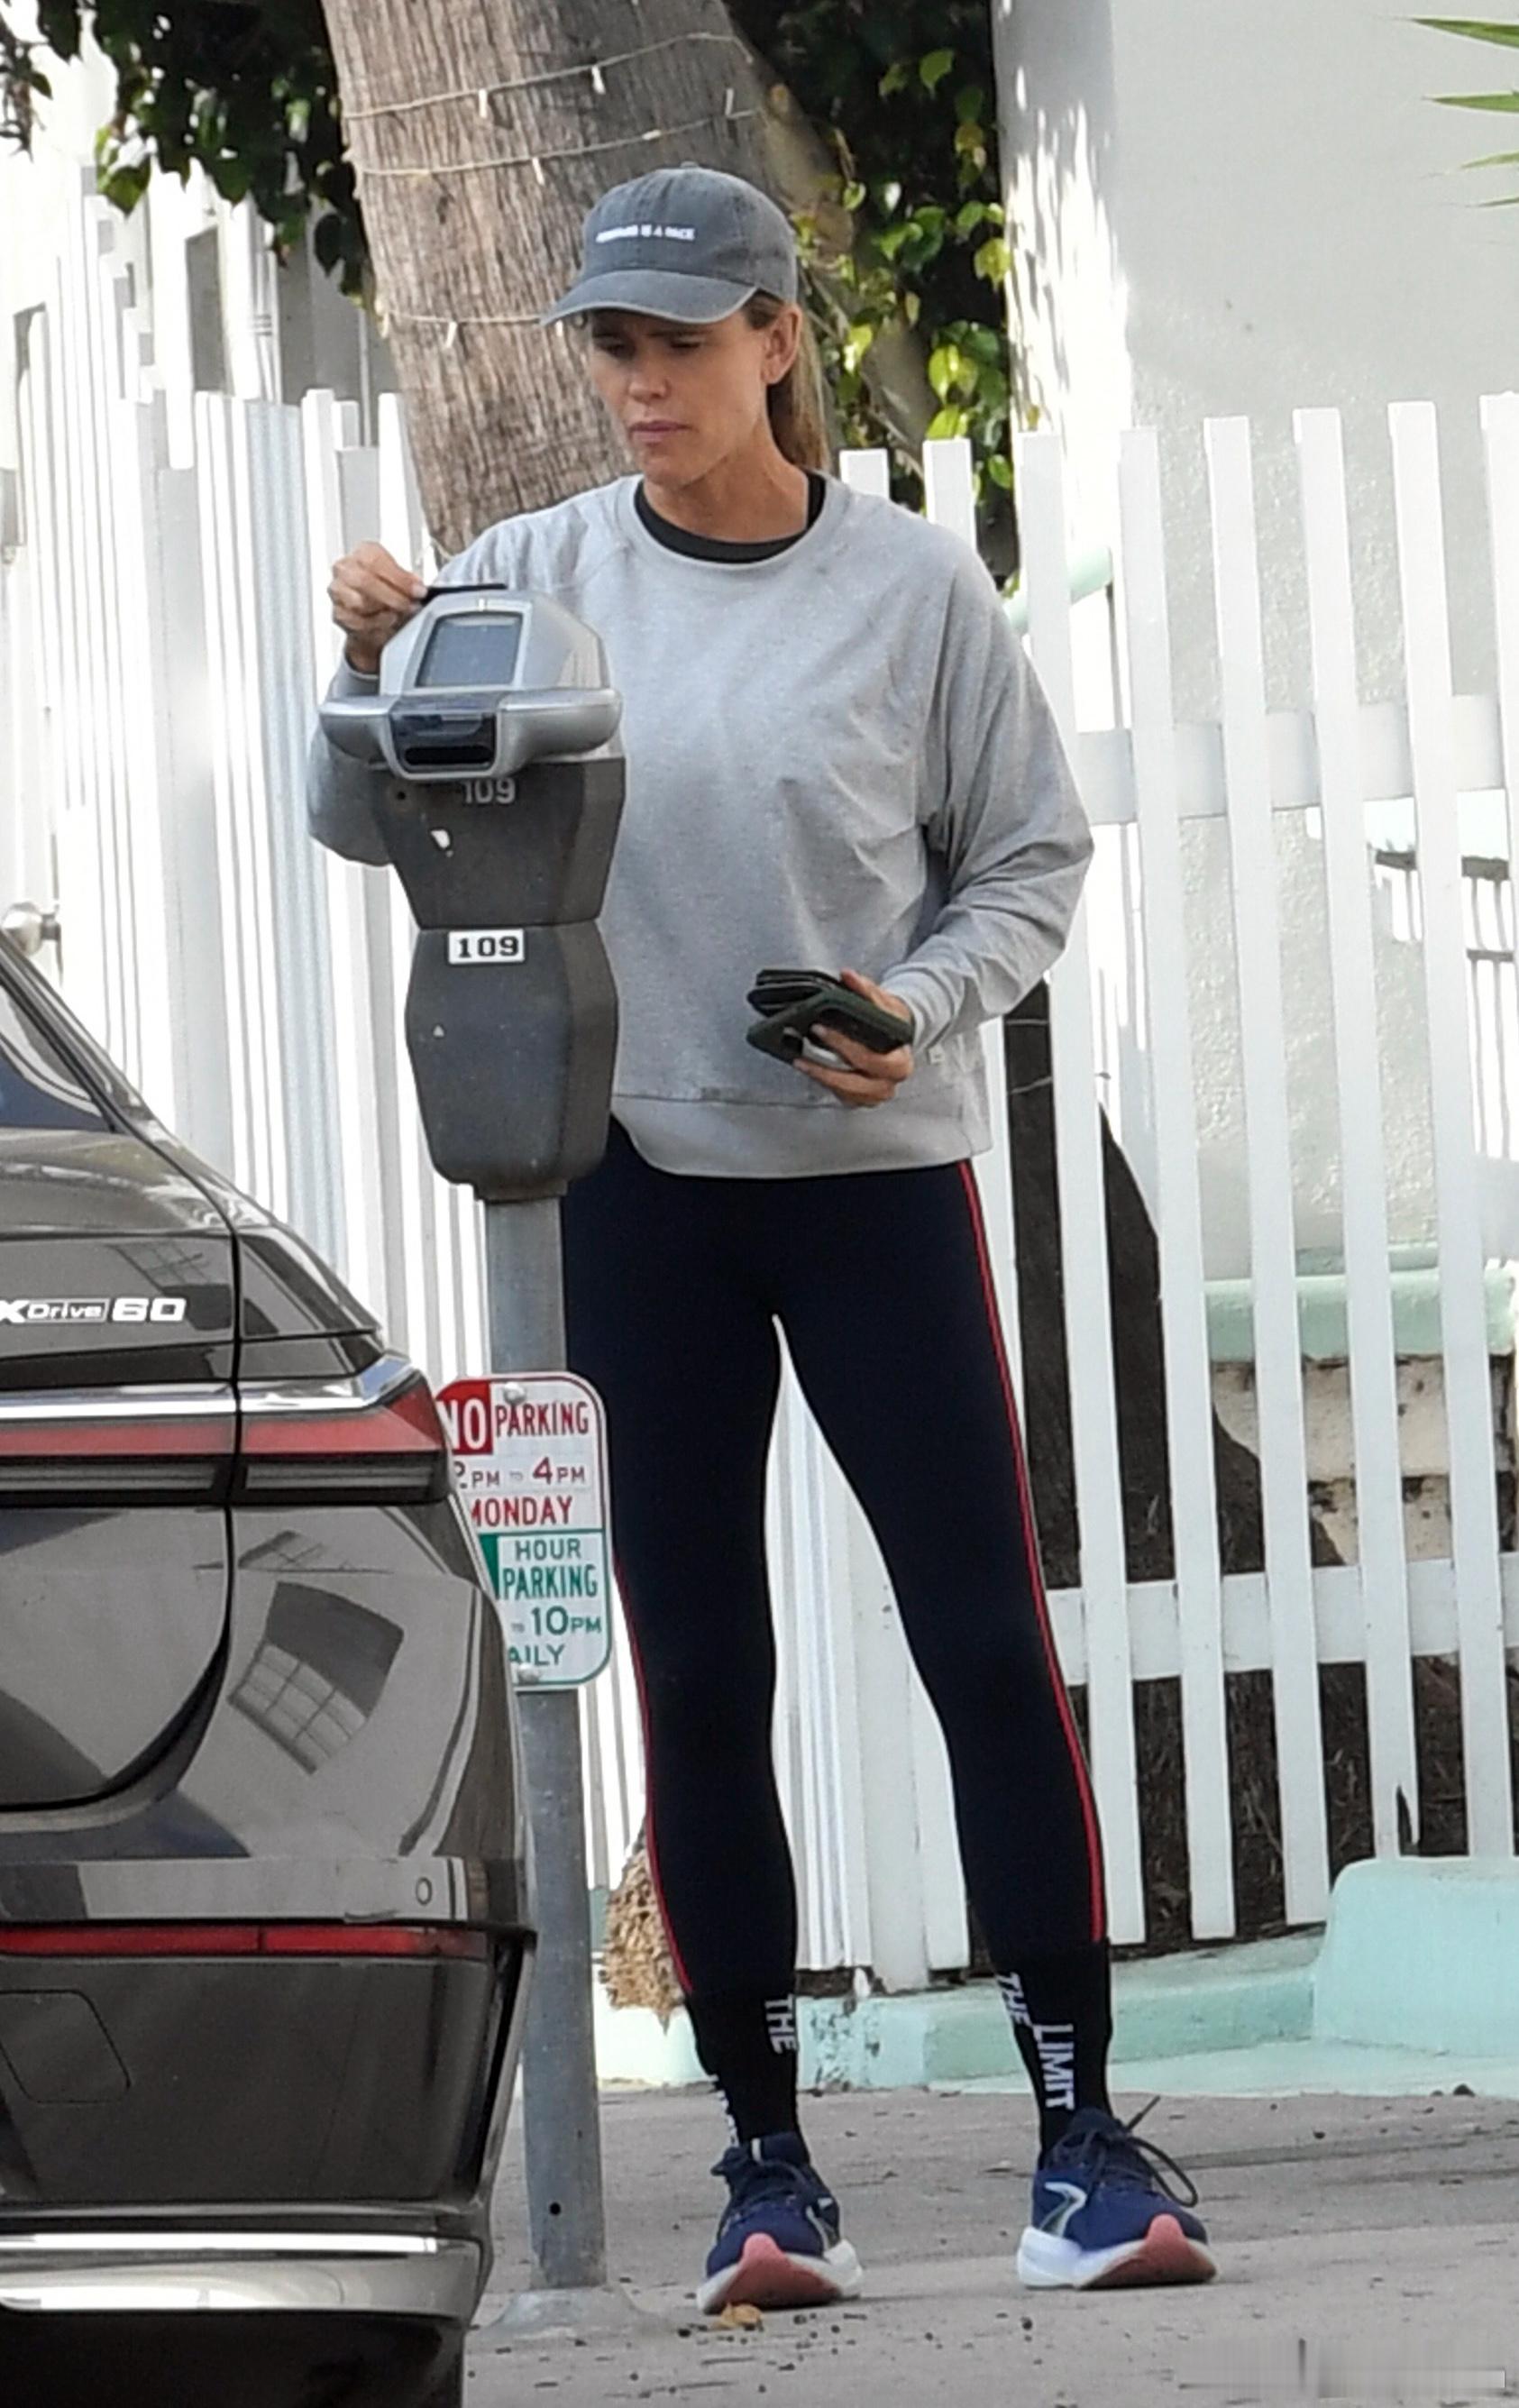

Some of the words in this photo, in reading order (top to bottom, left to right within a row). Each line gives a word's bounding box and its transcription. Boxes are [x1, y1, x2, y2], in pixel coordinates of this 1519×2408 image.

[462, 777, 516, 804] 109
[458, 936, 519, 958] 109
[112, 1297, 187, 1322] 60
[435, 1398, 488, 1450] NO
[495, 1401, 589, 1438] PARKING
[515, 1538, 581, 1561] HOUR
[502, 1564, 599, 1600] PARKING
[508, 1643, 565, 1667] AILY
[994, 1971, 1033, 2028] THE
[764, 1993, 800, 2055] THE
[1032, 2023, 1075, 2110] LIMIT
